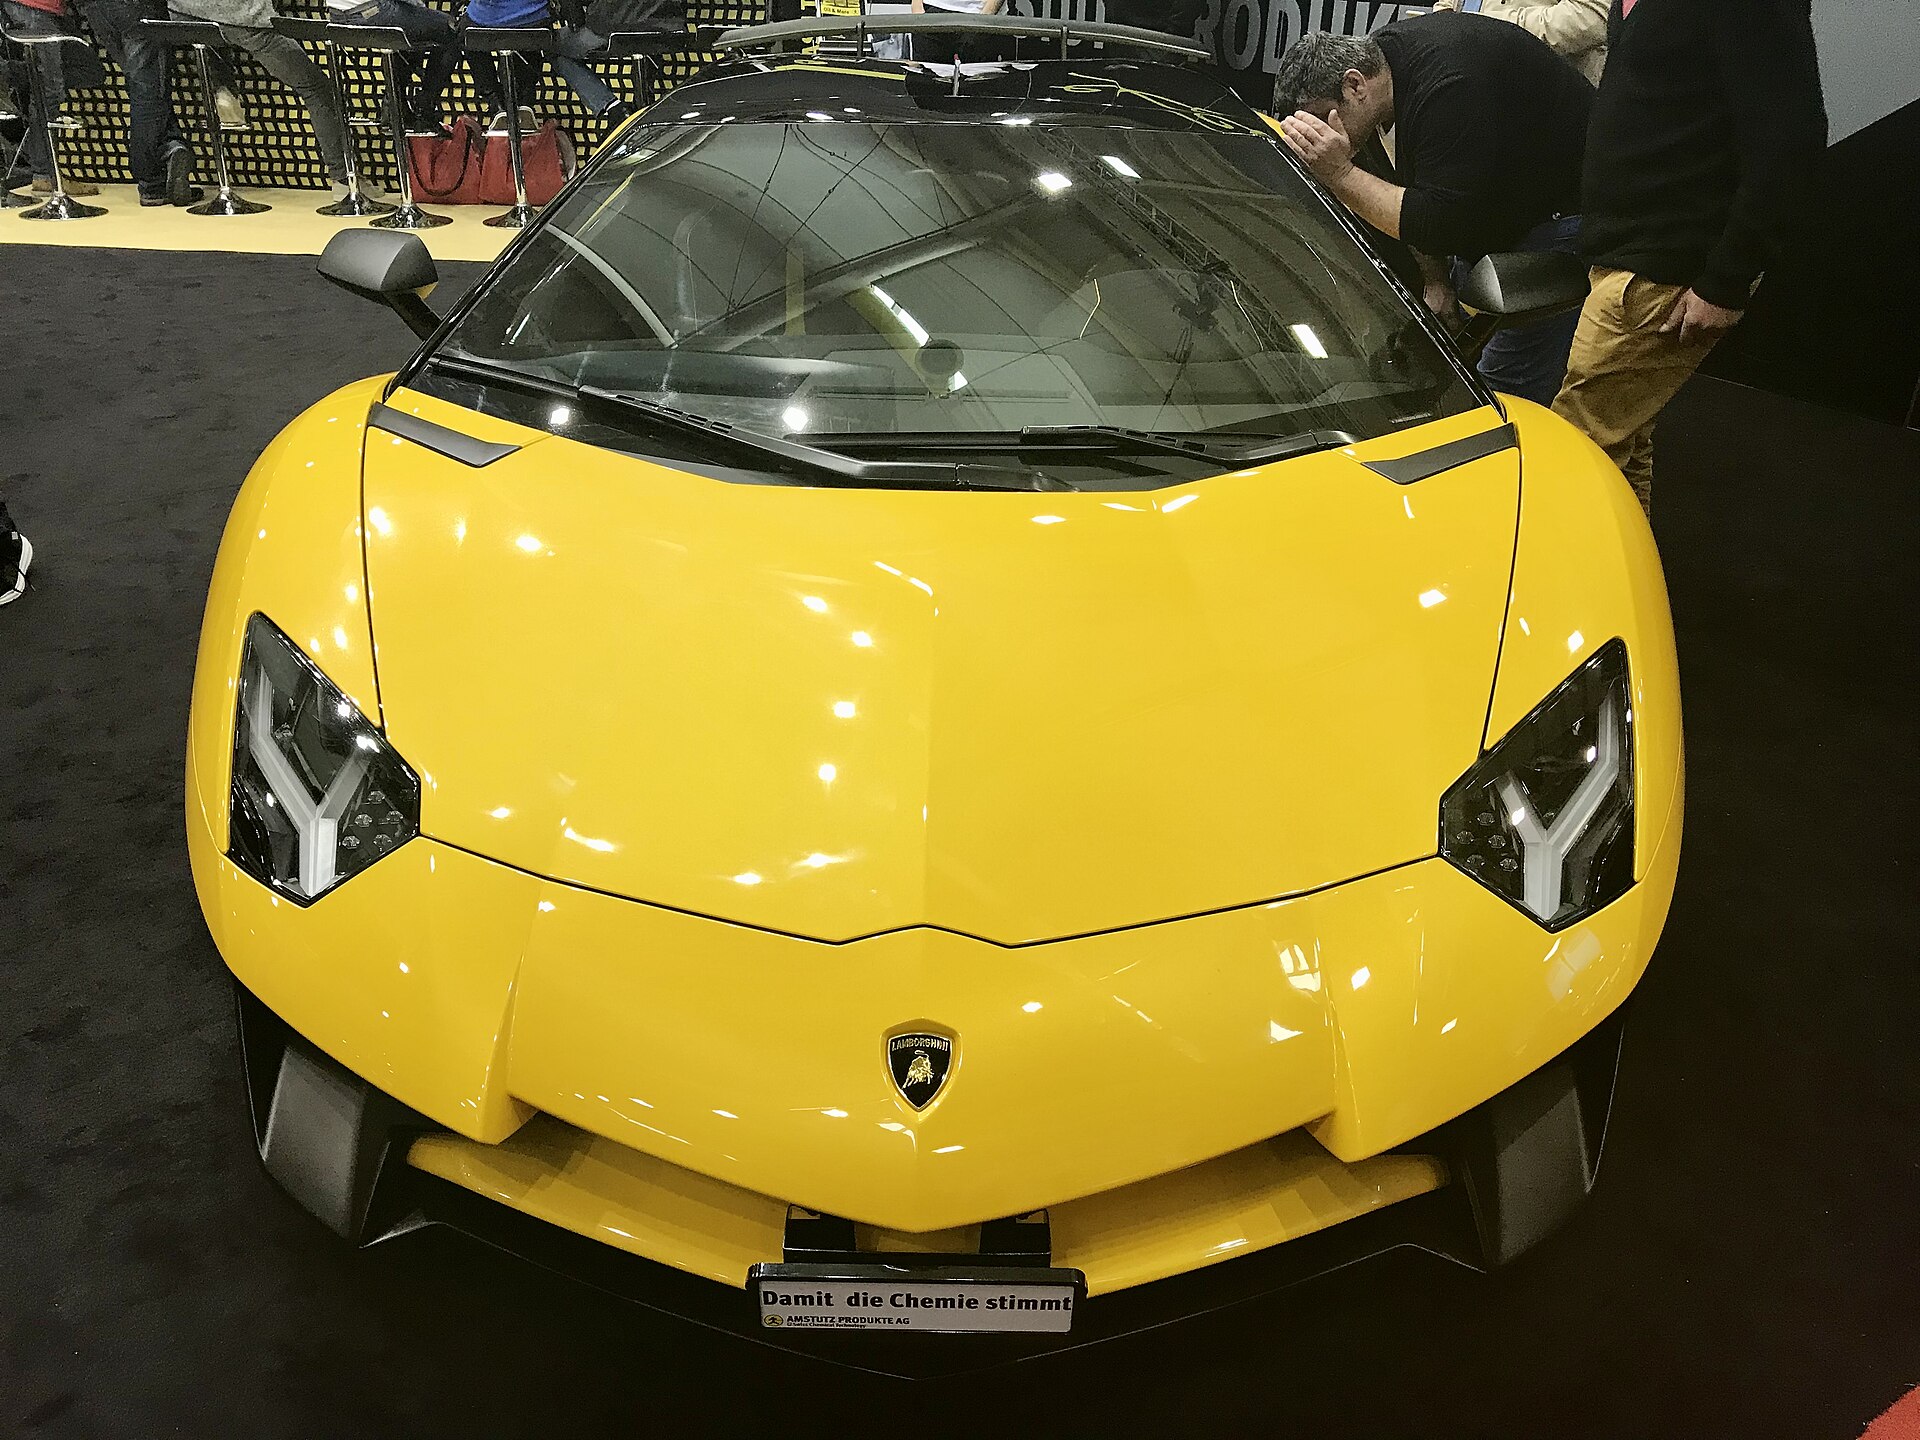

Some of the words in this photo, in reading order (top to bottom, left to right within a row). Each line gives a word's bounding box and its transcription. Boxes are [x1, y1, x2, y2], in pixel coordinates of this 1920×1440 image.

[892, 1037, 949, 1051] LAMBORGHINI
[762, 1290, 834, 1306] Damit
[846, 1291, 883, 1307] die
[889, 1293, 979, 1309] Chemie
[985, 1294, 1071, 1310] stimmt
[787, 1315, 836, 1323] AMSTUTZ
[838, 1316, 893, 1324] PRODUKTE
[895, 1317, 910, 1325] AG
